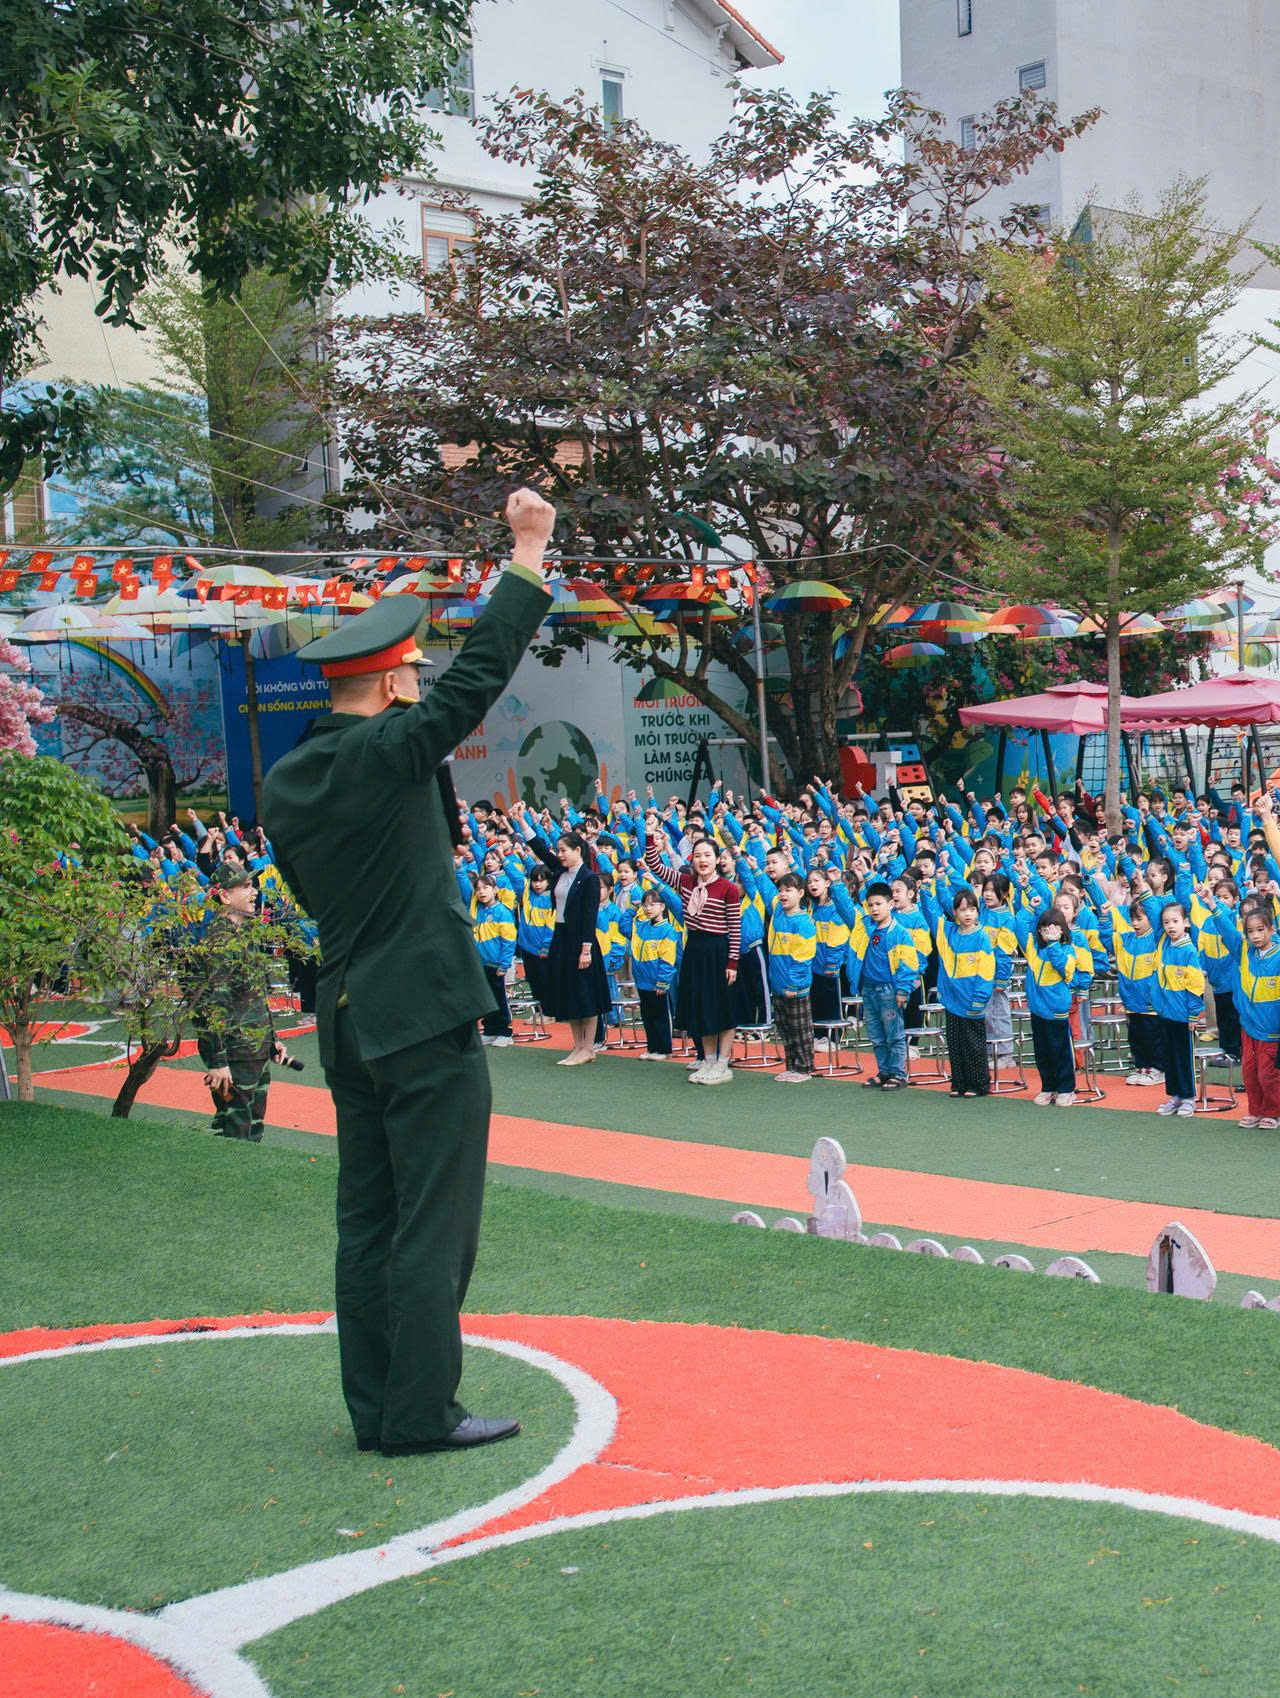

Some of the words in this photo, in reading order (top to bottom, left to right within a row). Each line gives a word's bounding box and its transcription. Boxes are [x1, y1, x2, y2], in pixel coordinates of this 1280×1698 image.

[263, 680, 297, 693] KHÔNG
[267, 698, 295, 712] SỐNG
[296, 700, 323, 711] XANH
[641, 711, 684, 727] TRƯỚC
[689, 714, 710, 726] KHI
[635, 731, 660, 746] MÔI
[644, 749, 671, 764] LÀM
[645, 766, 693, 783] CHÚNG
